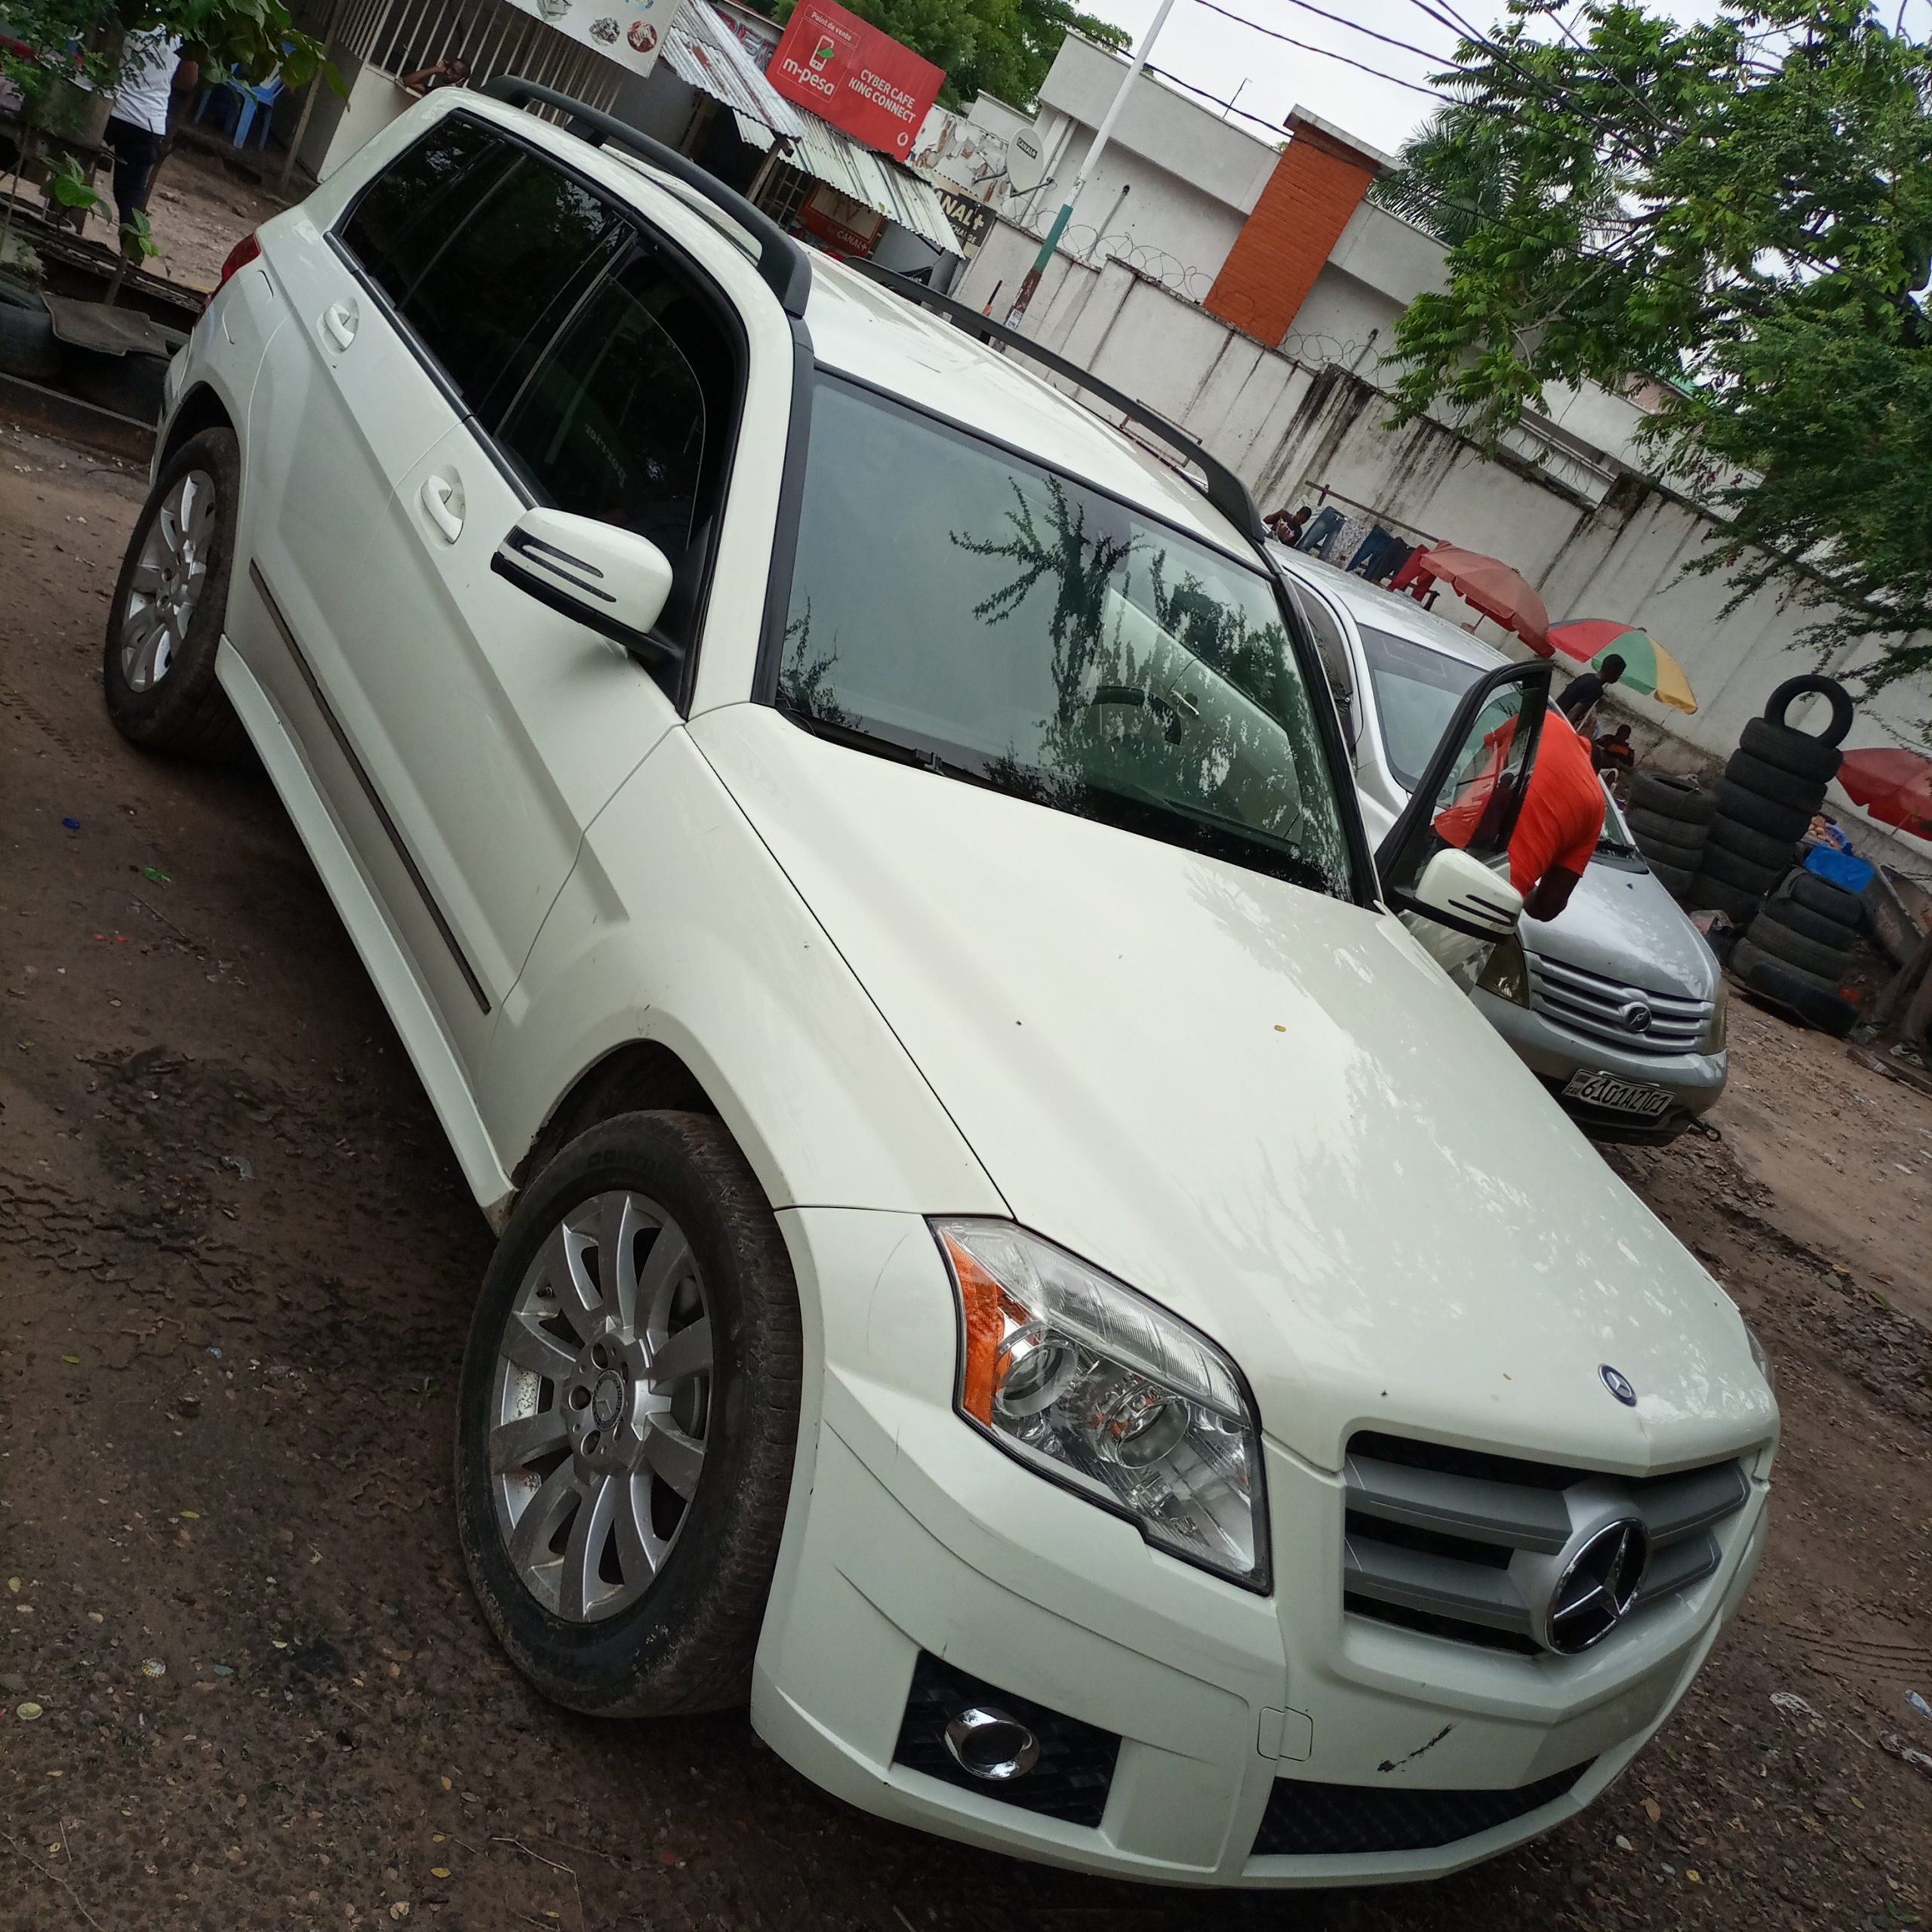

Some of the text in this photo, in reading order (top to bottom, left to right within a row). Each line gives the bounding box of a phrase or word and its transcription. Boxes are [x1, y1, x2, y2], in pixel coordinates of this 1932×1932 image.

[811, 11, 828, 26] Point
[835, 27, 852, 42] vente
[783, 57, 835, 97] m-pesa
[860, 69, 915, 109] CYBER CAFE
[848, 76, 916, 124] KING CONNECT
[1018, 139, 1036, 157] CANAL+
[838, 230, 867, 251] CANAL+
